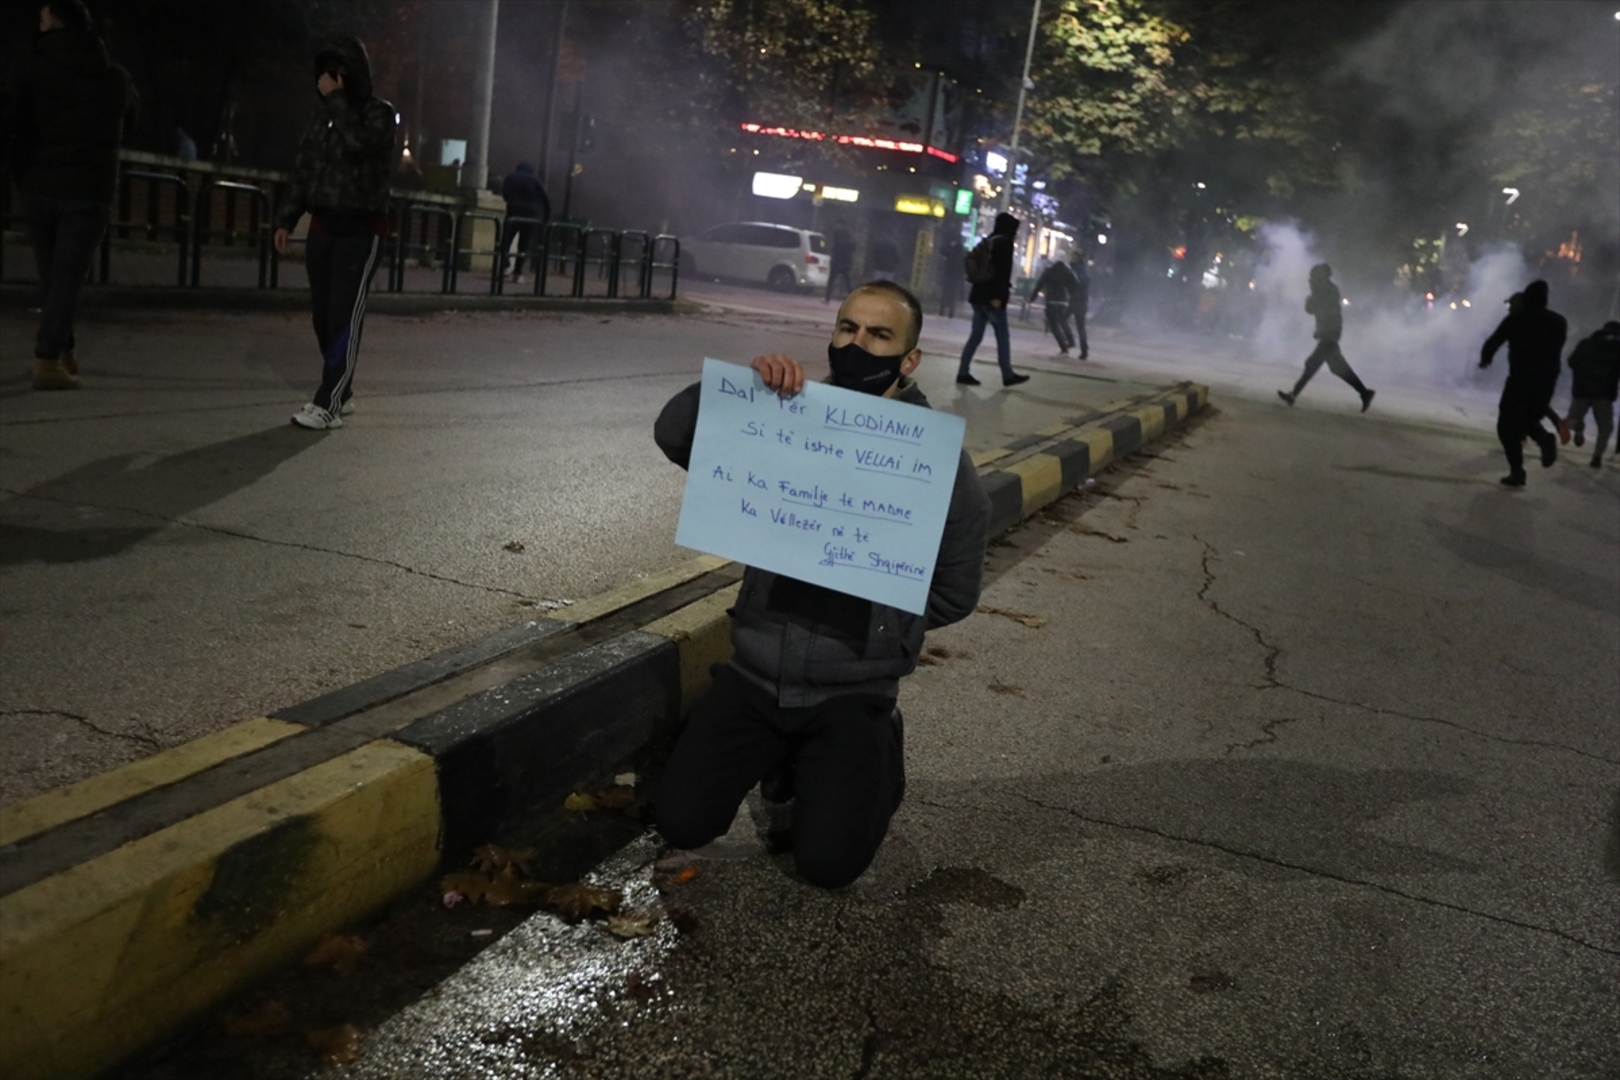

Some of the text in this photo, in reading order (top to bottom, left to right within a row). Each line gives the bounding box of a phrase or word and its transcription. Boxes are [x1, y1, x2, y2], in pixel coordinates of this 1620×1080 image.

[718, 377, 755, 403] Dal
[741, 421, 765, 437] Si
[776, 428, 795, 445] të
[805, 437, 844, 459] ishte
[712, 465, 734, 482] Ai
[778, 481, 829, 508] Familje
[838, 493, 854, 508] të
